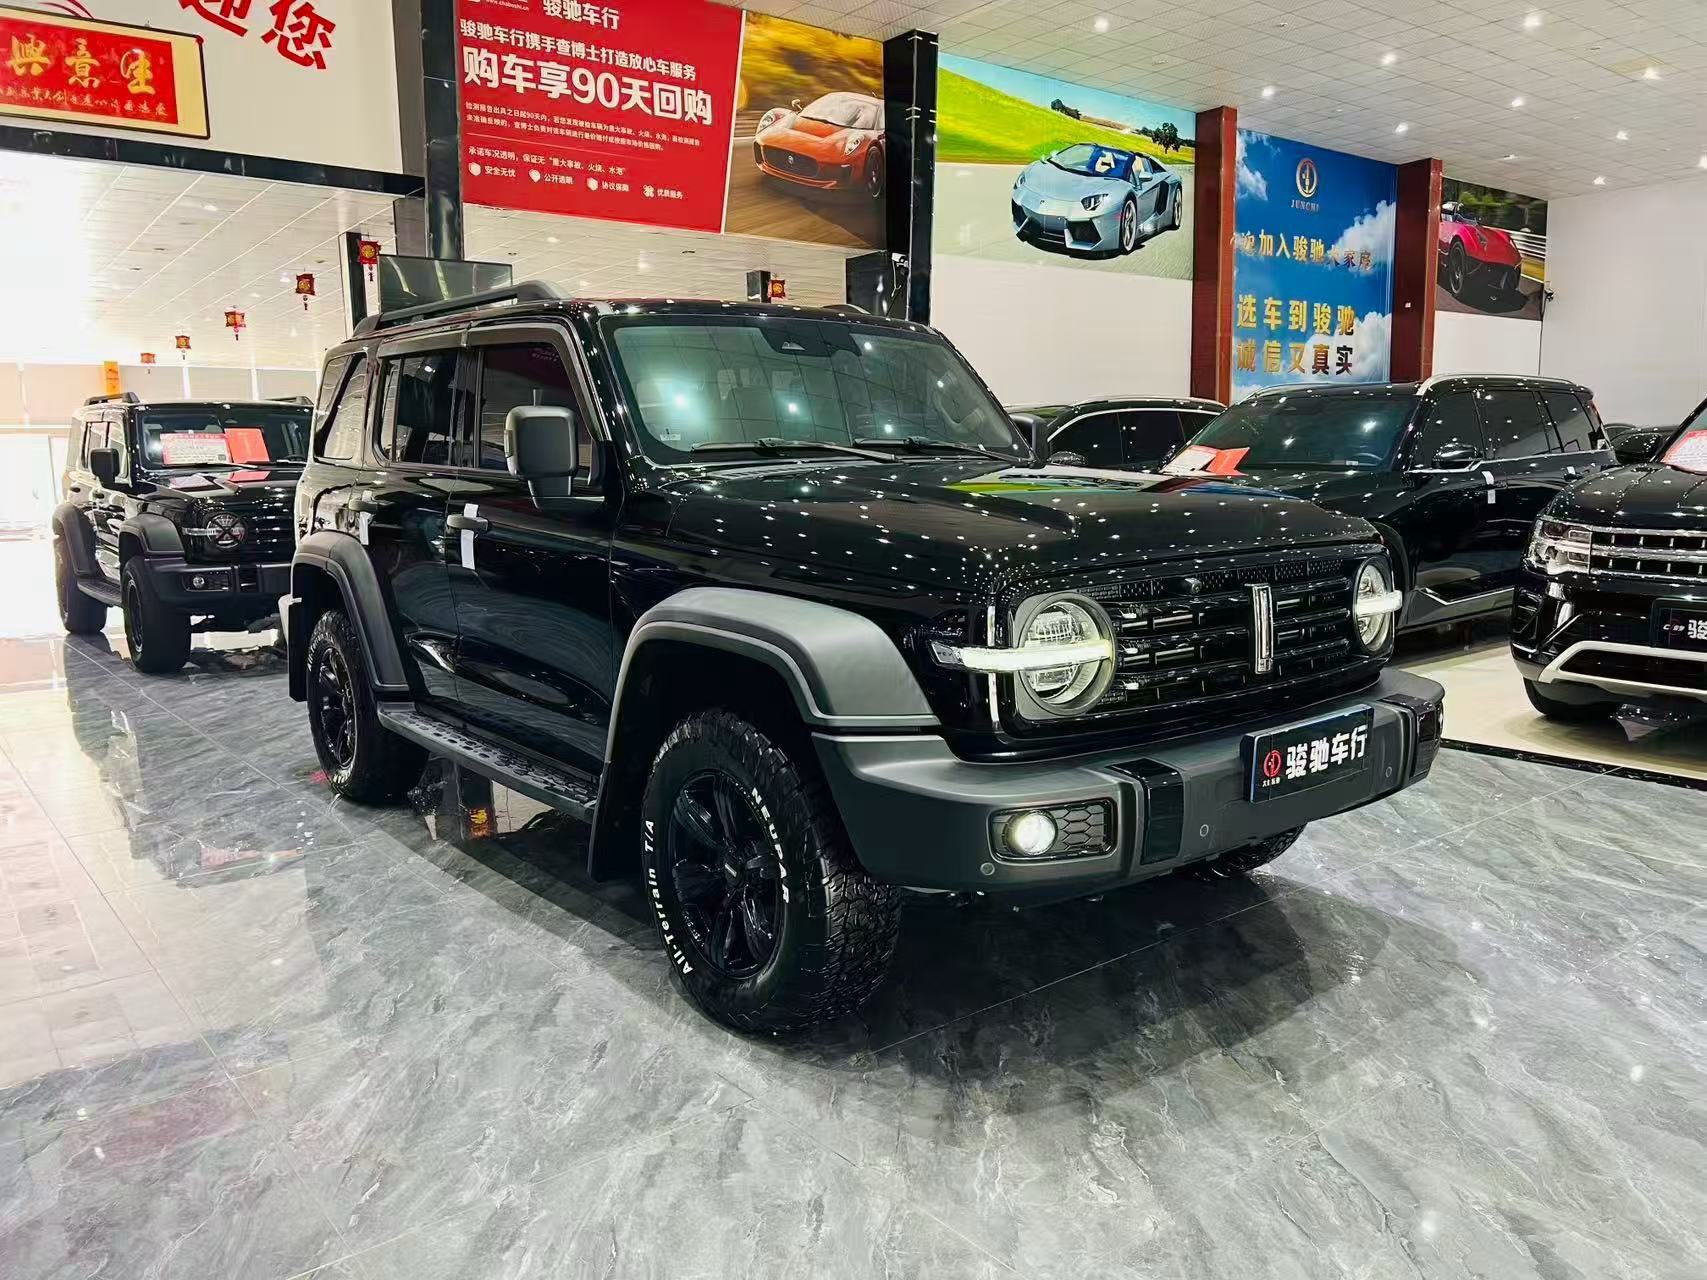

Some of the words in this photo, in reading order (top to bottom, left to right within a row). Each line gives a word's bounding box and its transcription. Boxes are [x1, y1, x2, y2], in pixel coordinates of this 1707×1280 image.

[543, 0, 619, 30] 骏驰车行
[460, 19, 696, 81] 骏驰车行携手查博士打造放心车服务
[462, 46, 712, 125] 购车享90天回购
[1237, 294, 1356, 336] 选车到骏驰
[1237, 338, 1354, 375] 诚信又真实
[1286, 724, 1368, 780] 骏驰车行
[644, 820, 656, 853] T/A
[648, 868, 695, 975] All-Terrain
